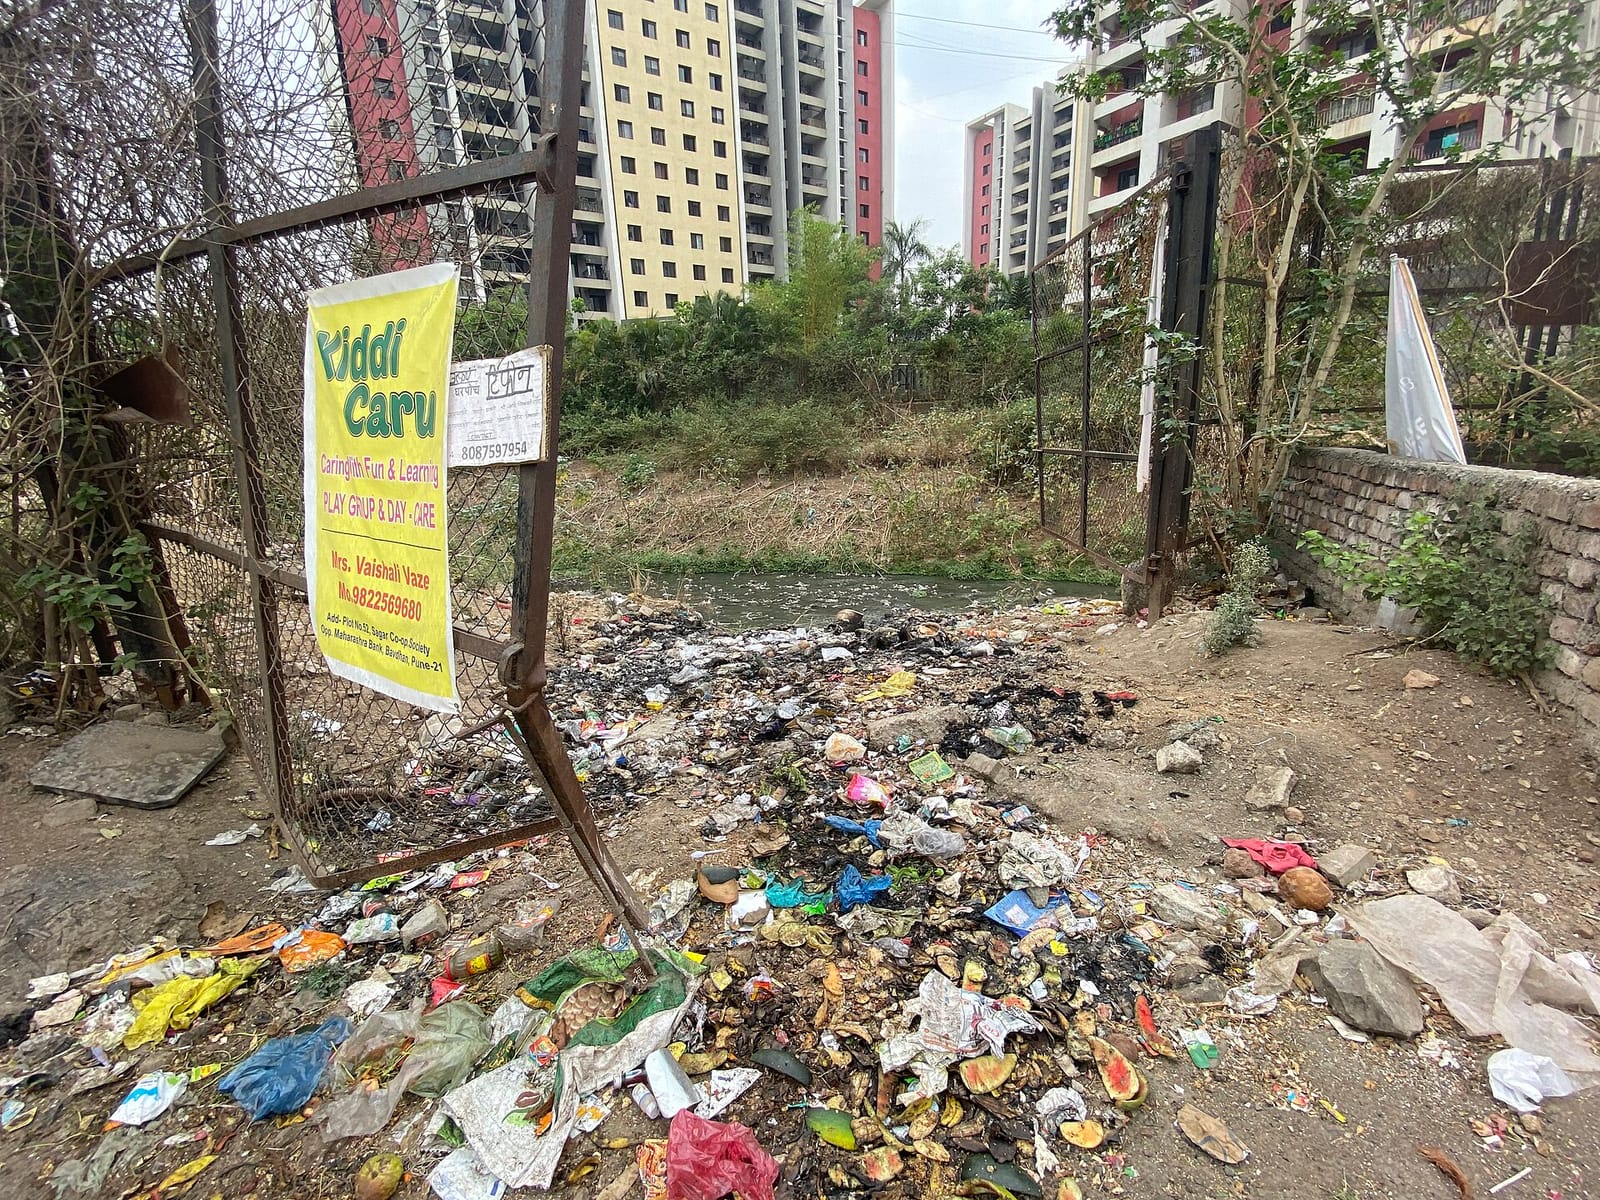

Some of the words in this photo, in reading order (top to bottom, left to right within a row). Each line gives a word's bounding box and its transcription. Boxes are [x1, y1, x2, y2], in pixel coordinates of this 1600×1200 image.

[316, 317, 408, 383] Kiddi
[343, 383, 437, 438] Caru
[461, 441, 527, 460] 8087597954
[364, 457, 384, 479] Fun
[387, 458, 396, 480] &
[323, 491, 346, 515] PLAY
[378, 498, 385, 522] &
[387, 499, 407, 524] DAY
[413, 501, 436, 529] CARE
[356, 555, 401, 583] Vaishali
[402, 565, 430, 590] Vaze
[342, 615, 354, 628] Plot
[371, 625, 388, 641] Sagar
[411, 655, 443, 673] Pune-21
